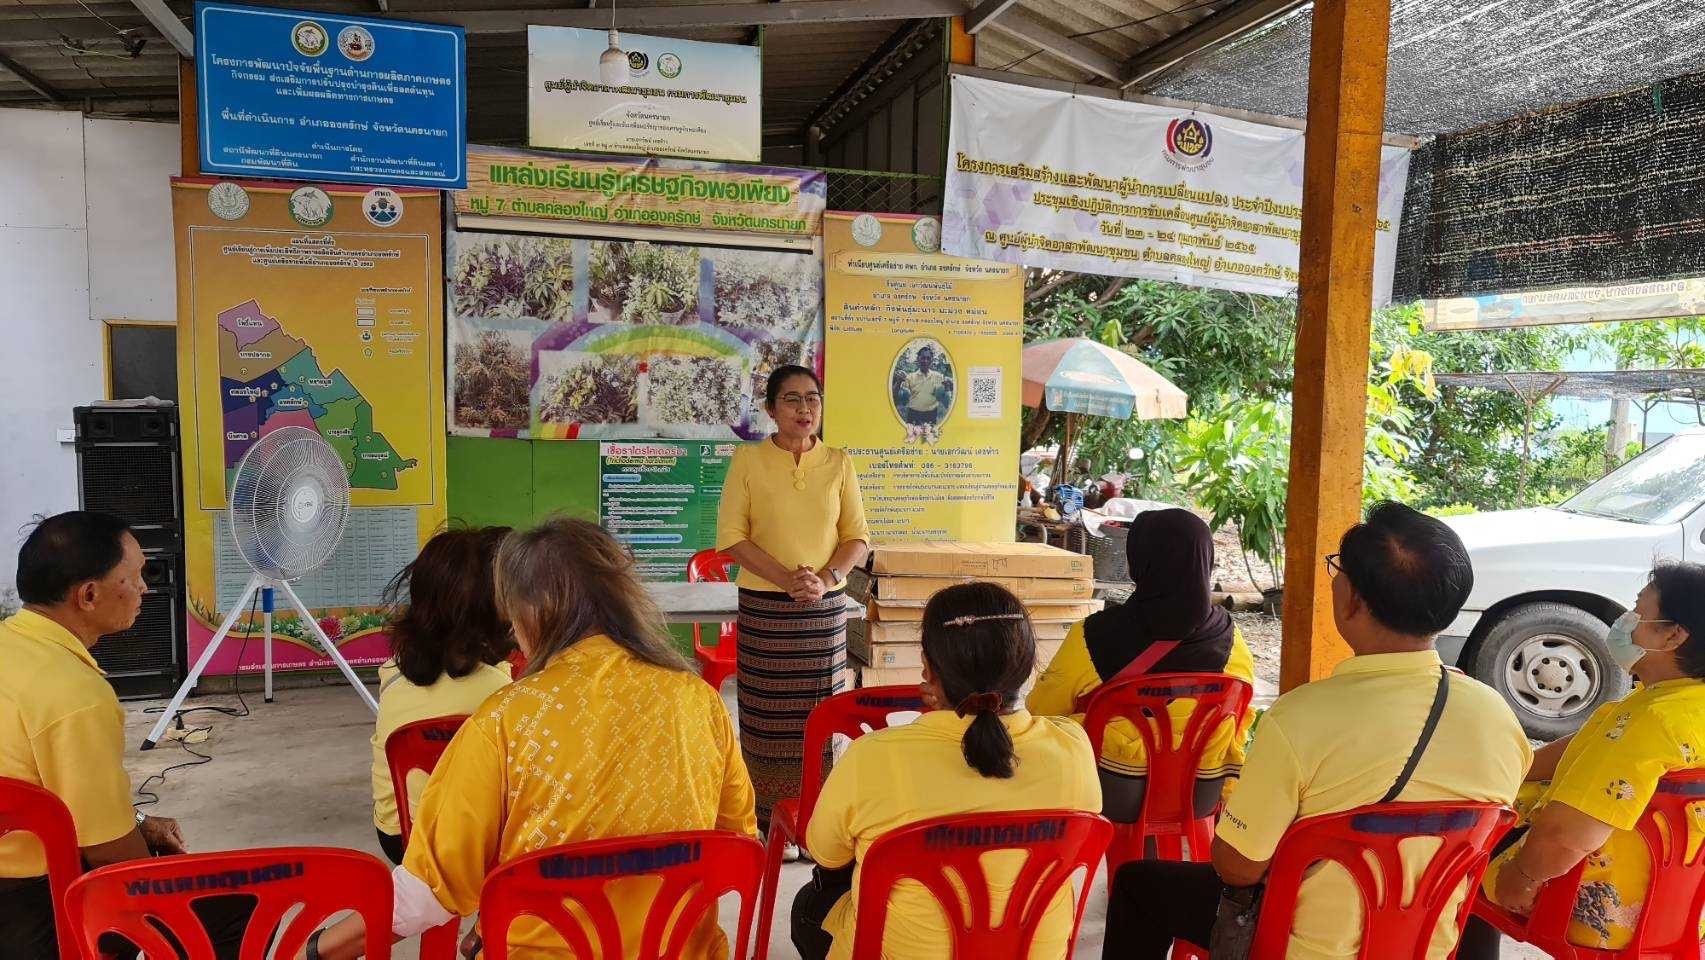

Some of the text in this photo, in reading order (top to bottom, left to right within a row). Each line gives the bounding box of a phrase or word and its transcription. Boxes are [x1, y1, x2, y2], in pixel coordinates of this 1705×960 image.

[221, 106, 448, 137] พื้นที่ดำเนินการ อำเภอองครักษ์ จังหวัดนครนายก
[489, 160, 792, 205] แหล่งเรียนรู้เศรษฐกิจพอเพียง
[470, 194, 807, 231] หมู่ 7 ตำบลคลองใหญ่ อำเภอองครักษ์ จังหวัดนครนายก
[1100, 219, 1123, 236] วันที่
